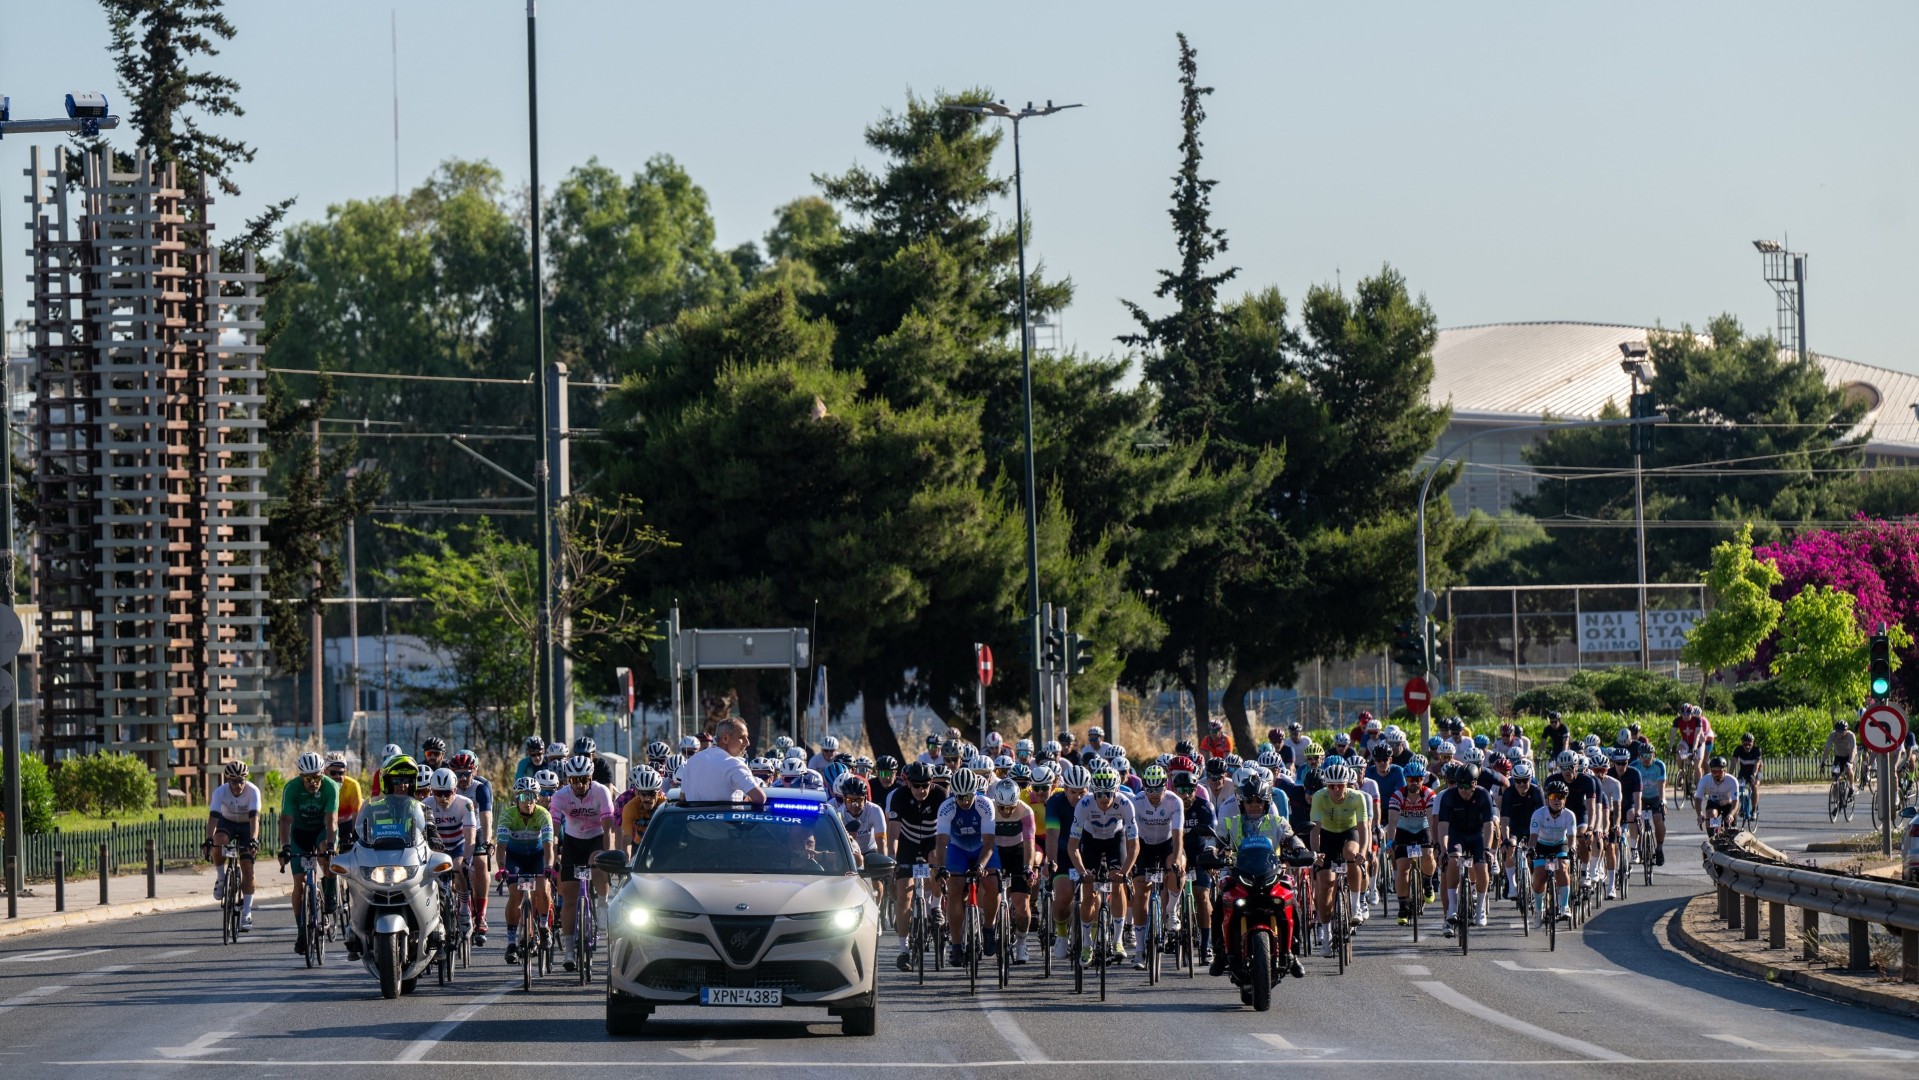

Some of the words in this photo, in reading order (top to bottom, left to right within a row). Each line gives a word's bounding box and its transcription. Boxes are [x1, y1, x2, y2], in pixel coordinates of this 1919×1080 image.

[1585, 613, 1622, 626] ΝΑΙ
[1585, 628, 1626, 640] ΟΧΙ
[1586, 640, 1650, 650] ΔΗΜΟ
[686, 813, 725, 821] RACE
[732, 813, 802, 824] DIRECTOR
